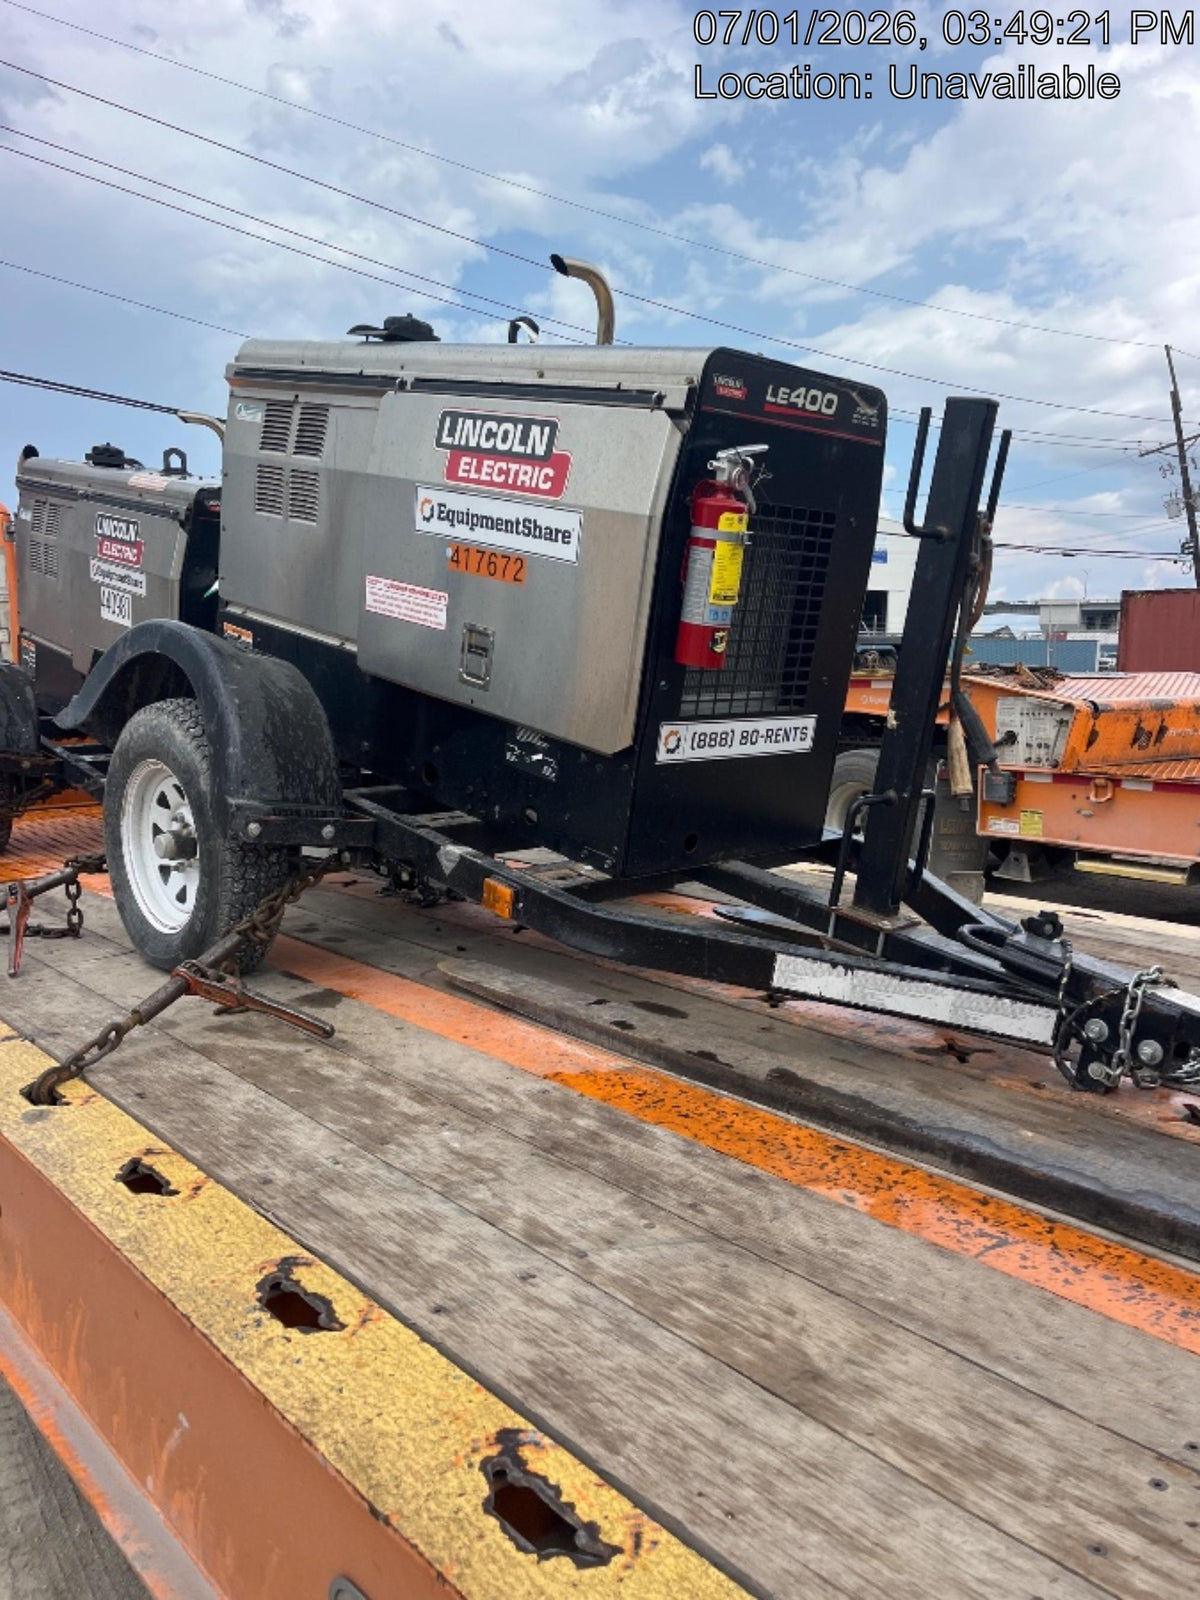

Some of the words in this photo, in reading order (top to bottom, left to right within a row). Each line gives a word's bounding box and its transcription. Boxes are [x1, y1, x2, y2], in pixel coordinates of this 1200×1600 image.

[765, 384, 839, 415] LE400
[440, 415, 551, 456] LINCOLN
[457, 456, 555, 490] ELECTRIC
[436, 502, 573, 545] EquipmentShare
[450, 545, 525, 582] 417672
[691, 728, 735, 751] (888)
